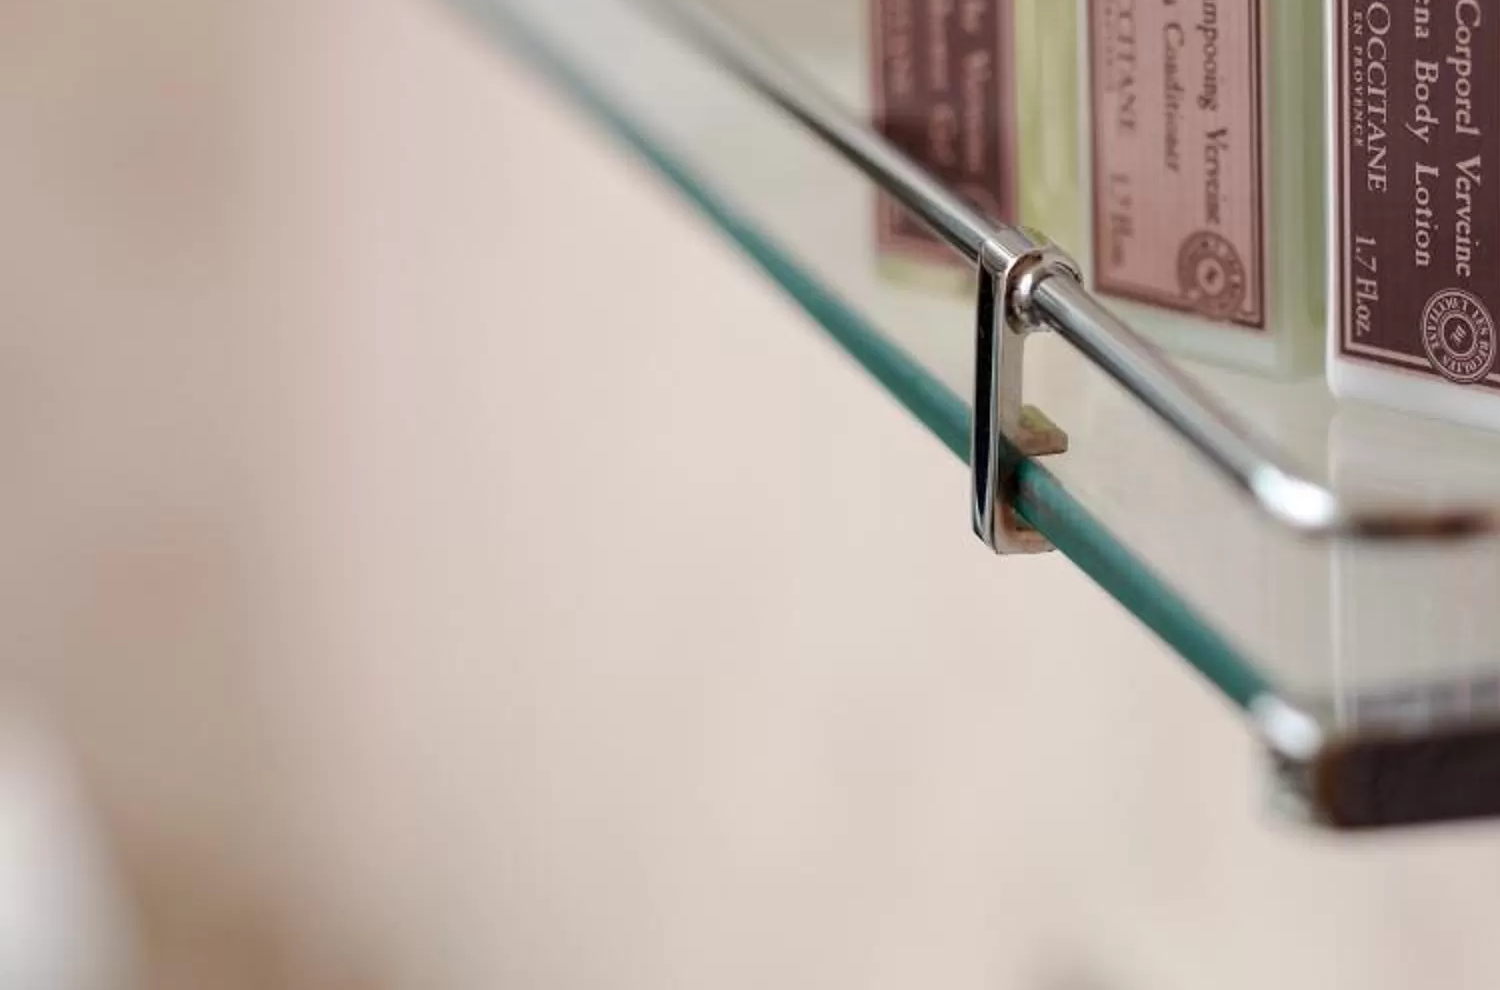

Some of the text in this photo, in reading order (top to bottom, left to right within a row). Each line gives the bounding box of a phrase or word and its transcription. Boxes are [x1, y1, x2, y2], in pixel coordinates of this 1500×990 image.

[1353, 11, 1364, 147] EN PROVENCE
[1404, 58, 1440, 144] Body
[1354, 234, 1378, 274] 1.7
[1415, 161, 1440, 267] Lotion
[1455, 154, 1481, 278] Verveine
